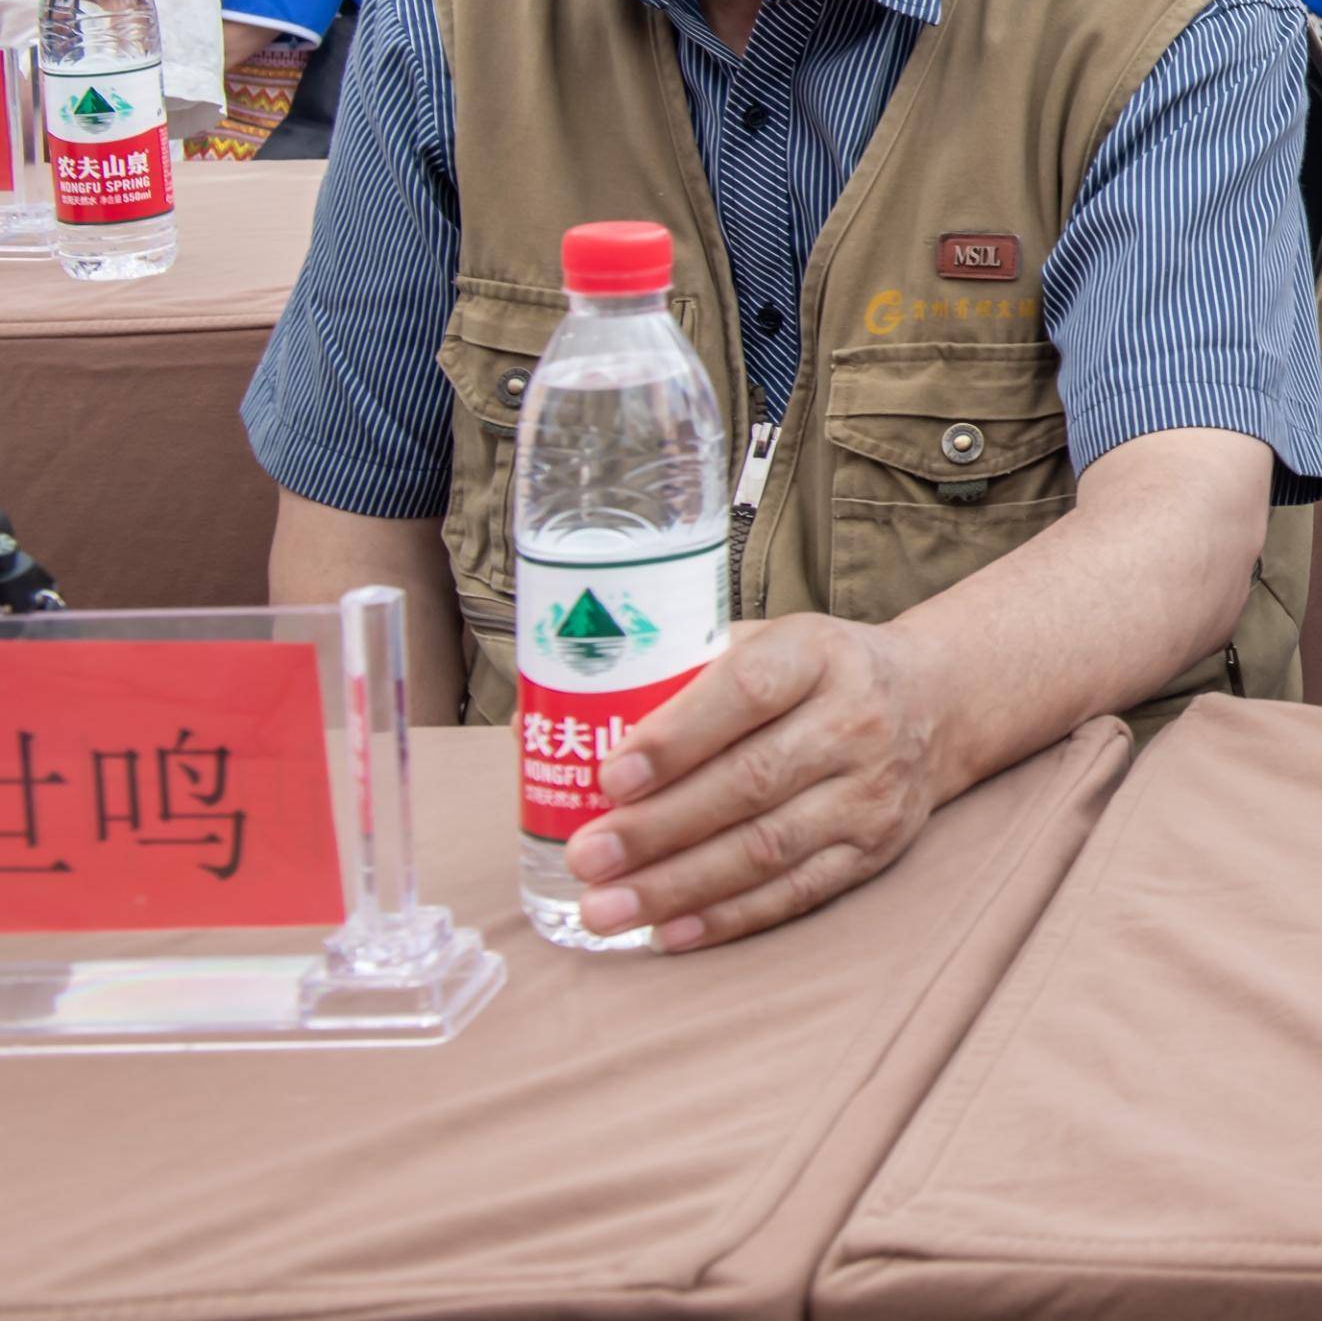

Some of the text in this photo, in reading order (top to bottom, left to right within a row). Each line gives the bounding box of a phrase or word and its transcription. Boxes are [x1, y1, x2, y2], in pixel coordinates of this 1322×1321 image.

[57, 151, 150, 180] 农夫山泉
[60, 175, 150, 195] NONGFU SPRING
[523, 758, 592, 788] NONGFU
